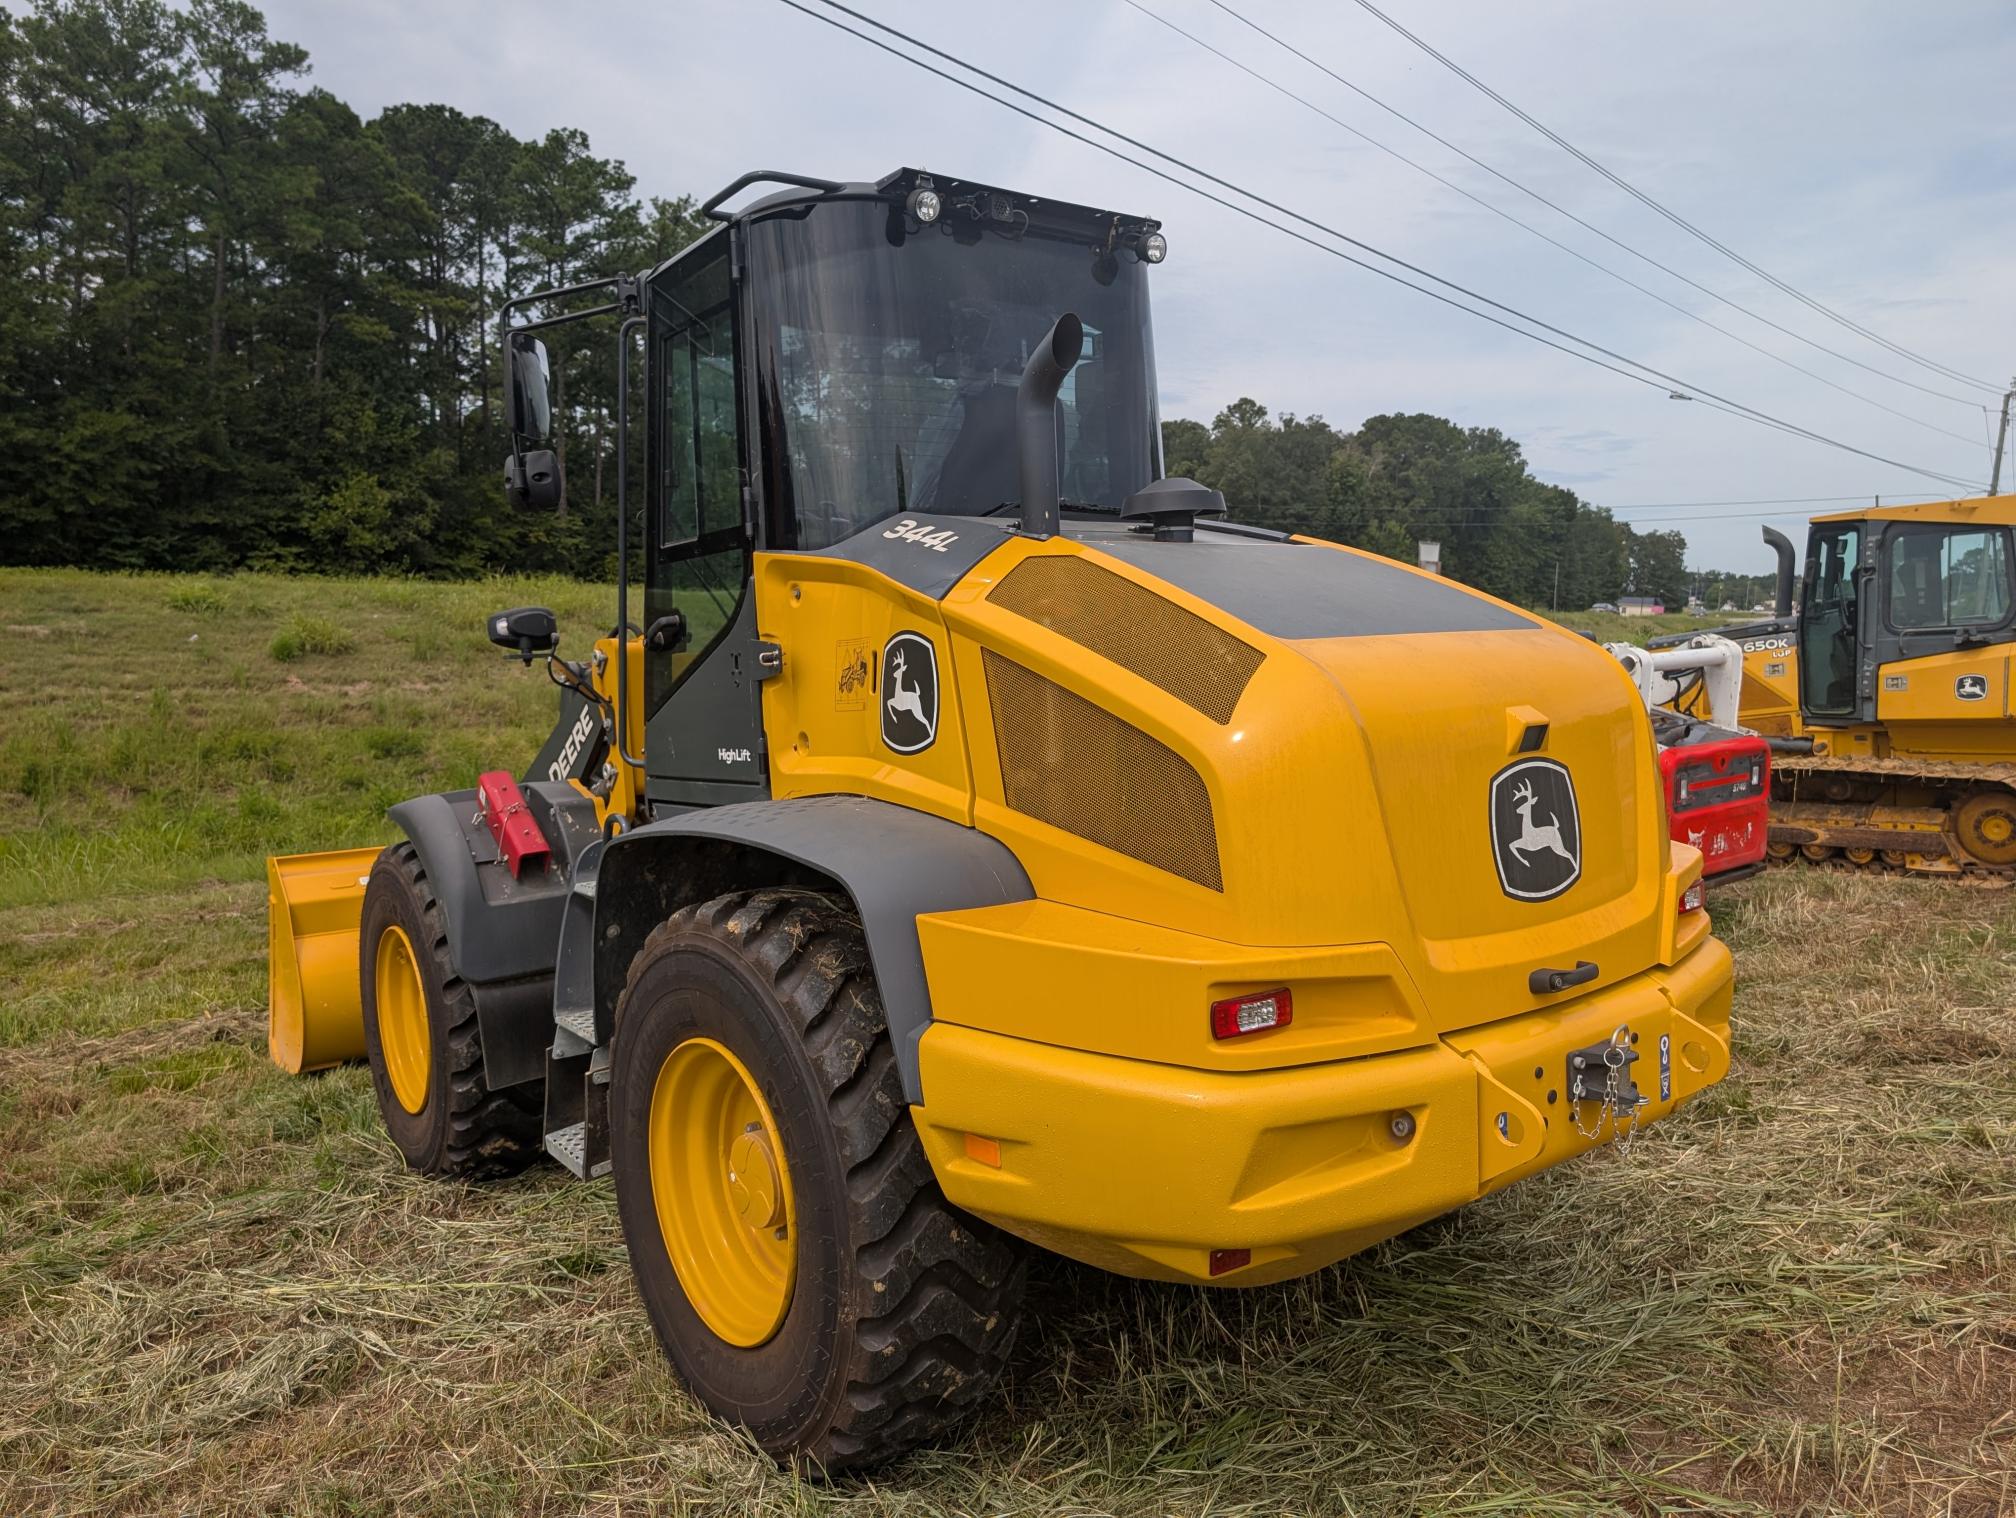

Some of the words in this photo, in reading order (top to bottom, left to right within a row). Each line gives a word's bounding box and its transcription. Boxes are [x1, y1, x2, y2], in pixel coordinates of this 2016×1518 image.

[882, 519, 959, 552] 344L
[1743, 638, 1789, 652] 650K
[548, 703, 594, 782] DEERE
